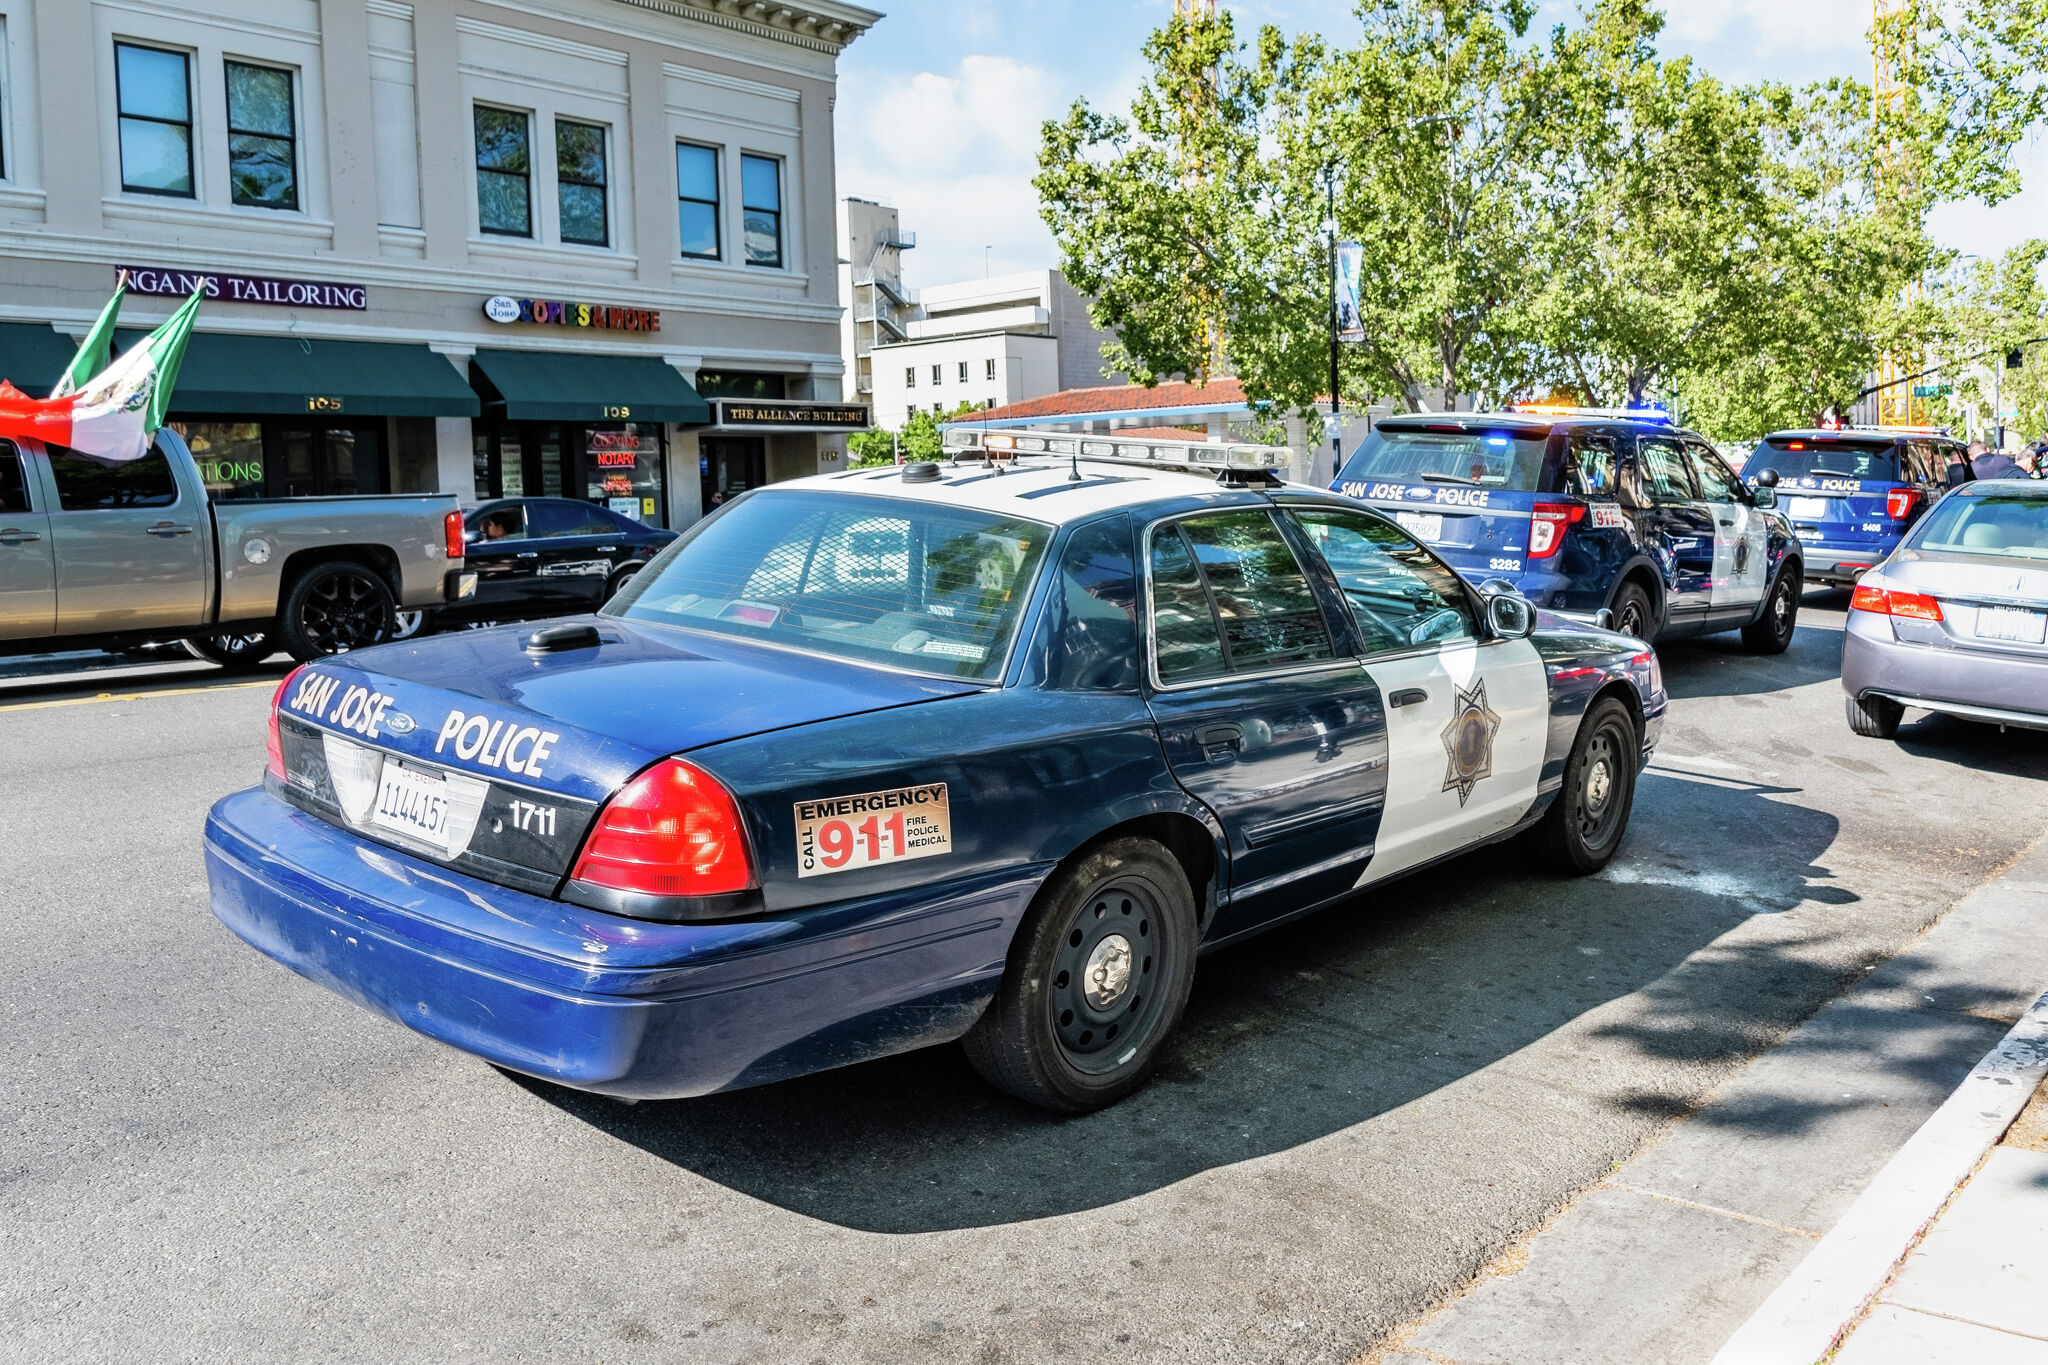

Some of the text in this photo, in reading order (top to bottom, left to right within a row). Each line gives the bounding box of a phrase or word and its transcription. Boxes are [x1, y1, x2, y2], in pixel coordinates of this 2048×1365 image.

[117, 268, 367, 308] NGANS TAILORING
[494, 298, 512, 308] San
[491, 307, 517, 318] Jose
[519, 299, 661, 332] COPIES & MORE
[730, 408, 863, 422] THE ALLIANCE BUILDING
[593, 435, 640, 449] COPYING
[597, 452, 636, 465] NOTARY
[1777, 477, 1798, 488] OSE
[1821, 479, 1861, 492] POLICE
[1340, 482, 1368, 498] SAN
[1368, 484, 1406, 501] JOSE
[1435, 488, 1490, 507] POLICE
[1489, 557, 1521, 571] 3282
[290, 672, 560, 778] SAN JOSE POLICE
[800, 787, 942, 821] EMERGENCY
[509, 799, 557, 837] 1711
[906, 815, 927, 827] FIRE
[907, 825, 940, 837] POLICE
[818, 811, 907, 869] 9-1-1
[908, 835, 948, 849] MEDICAL
[802, 825, 815, 870] CALL
